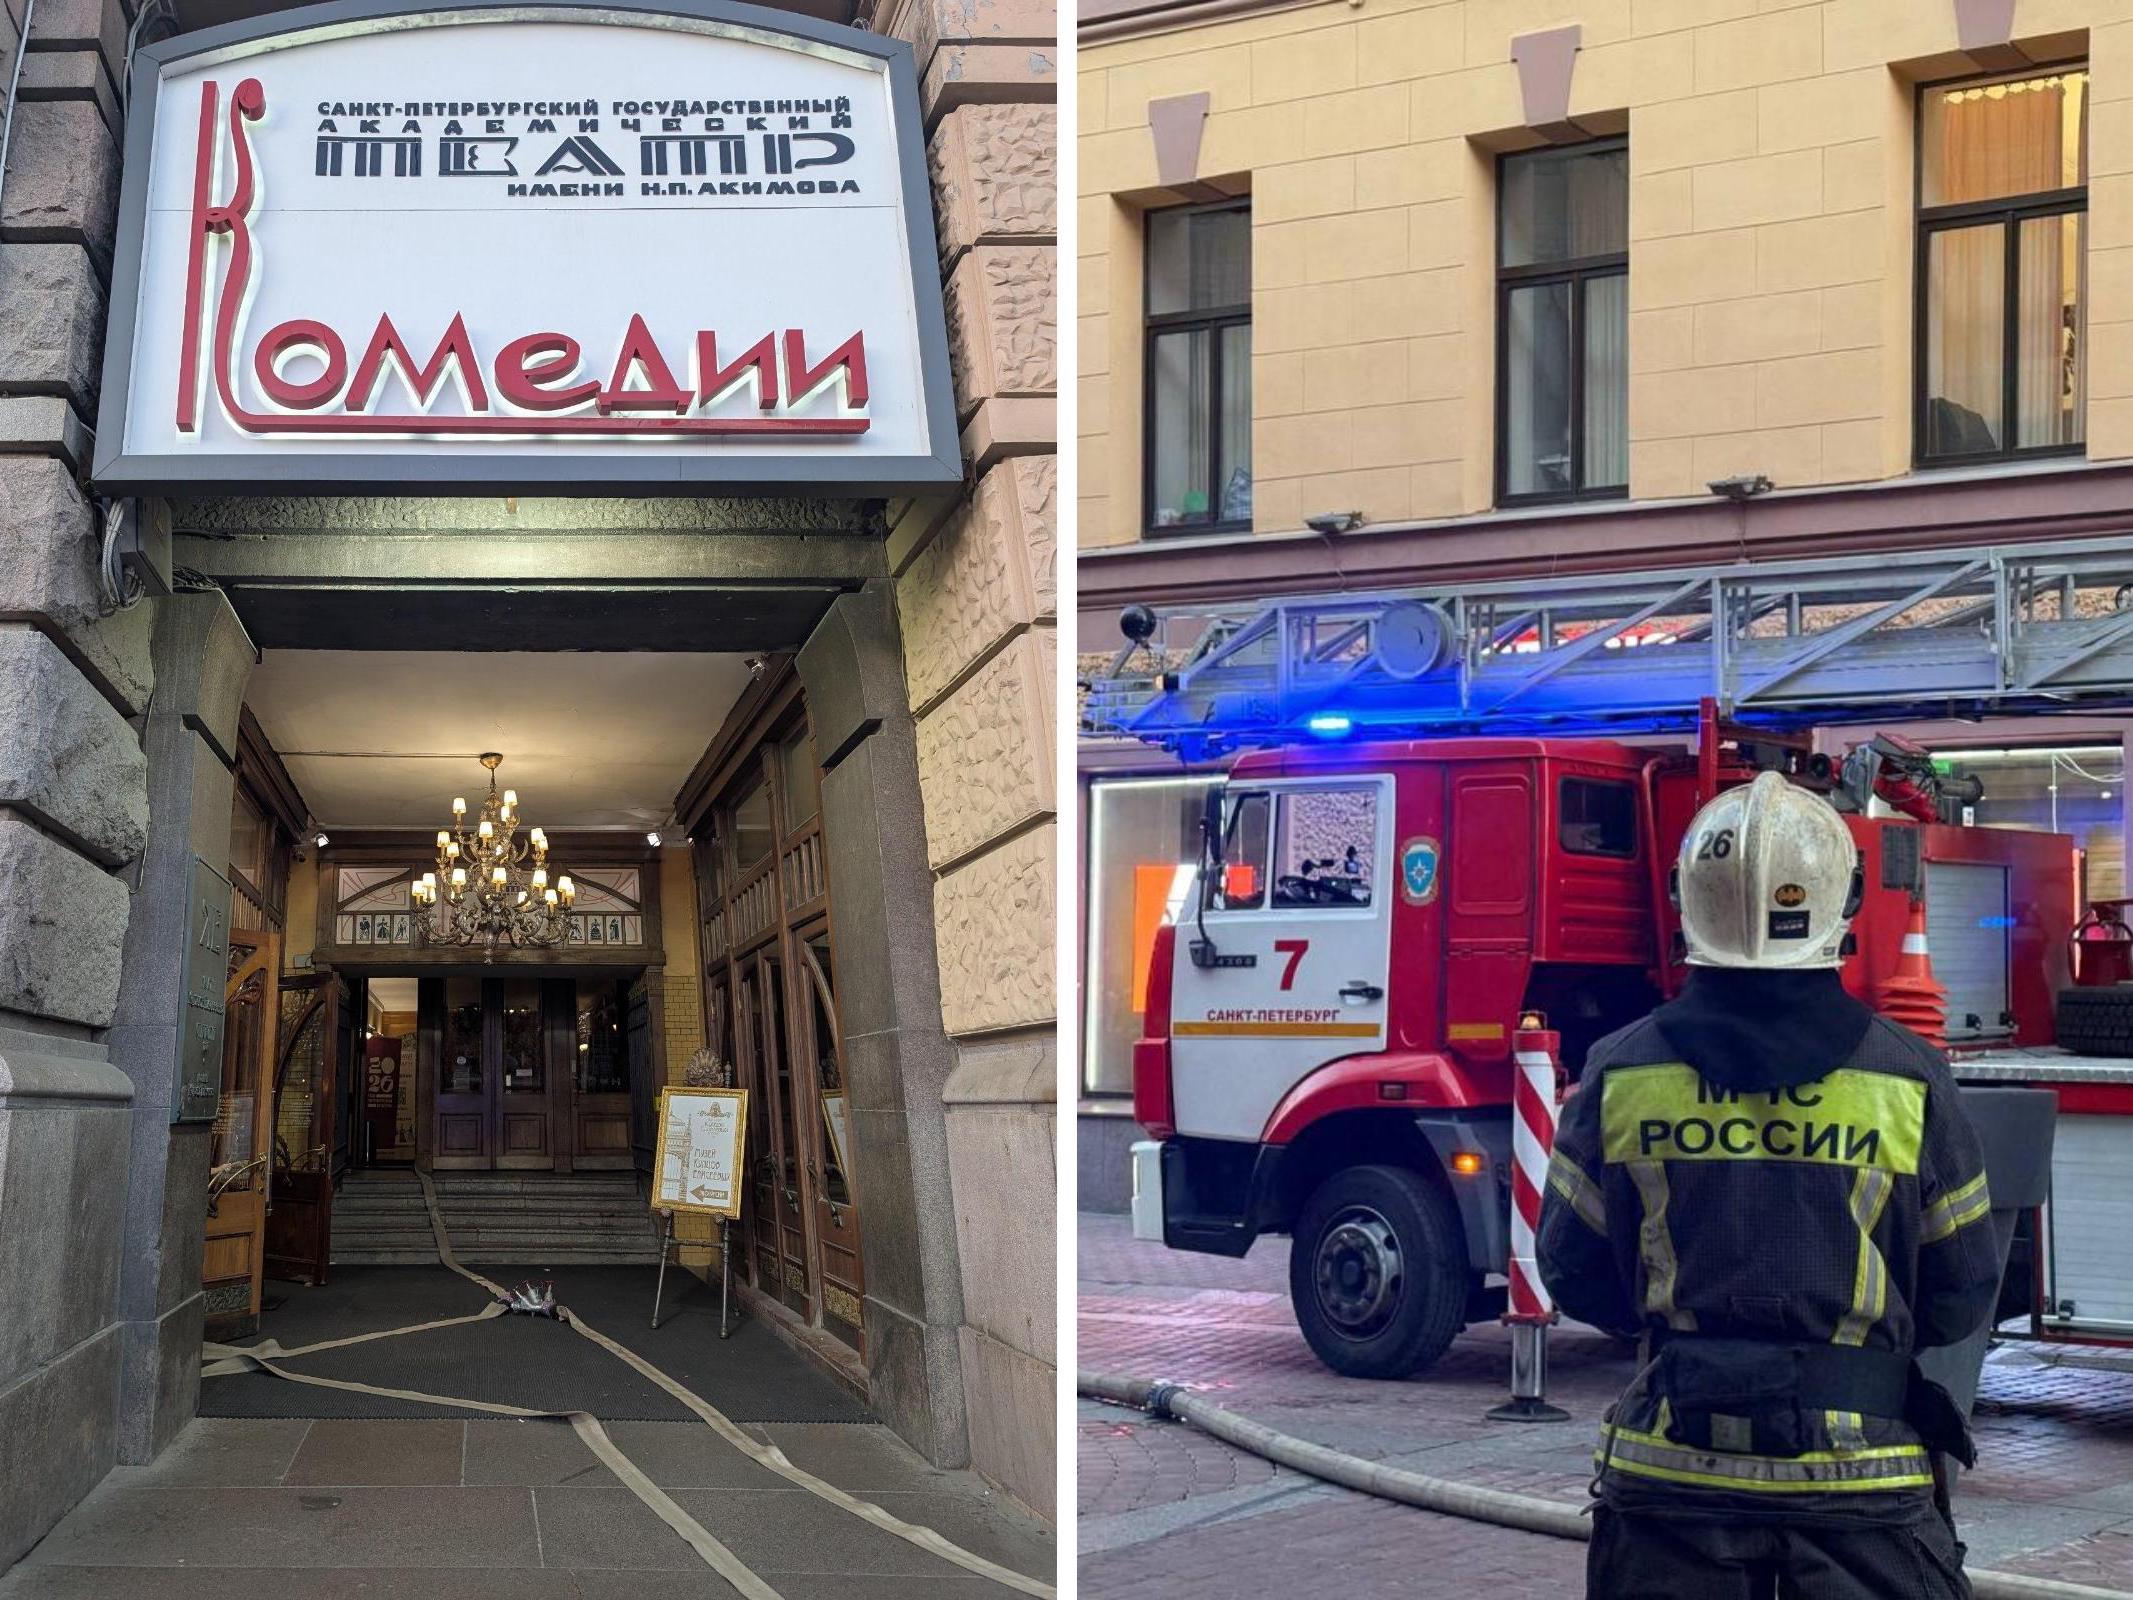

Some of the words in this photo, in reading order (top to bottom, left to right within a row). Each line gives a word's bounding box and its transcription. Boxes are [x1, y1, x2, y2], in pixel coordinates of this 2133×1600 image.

[317, 99, 599, 117] САНКТ-ПЕТЕРБУРГСКИЙ
[612, 96, 851, 117] ГОСУДАРСТВЕННЫЙ
[317, 112, 852, 136] АКАДЕМИЧЕСКИЙ
[315, 132, 856, 177] ТЕАТР
[507, 182, 624, 197] ИМЕНИ
[1698, 829, 1734, 860] 26
[1274, 939, 1309, 991] 7
[1207, 1009, 1341, 1022] САНКТ-ПЕТЕРБУРГ
[1639, 1117, 1880, 1164] РОССИИ
